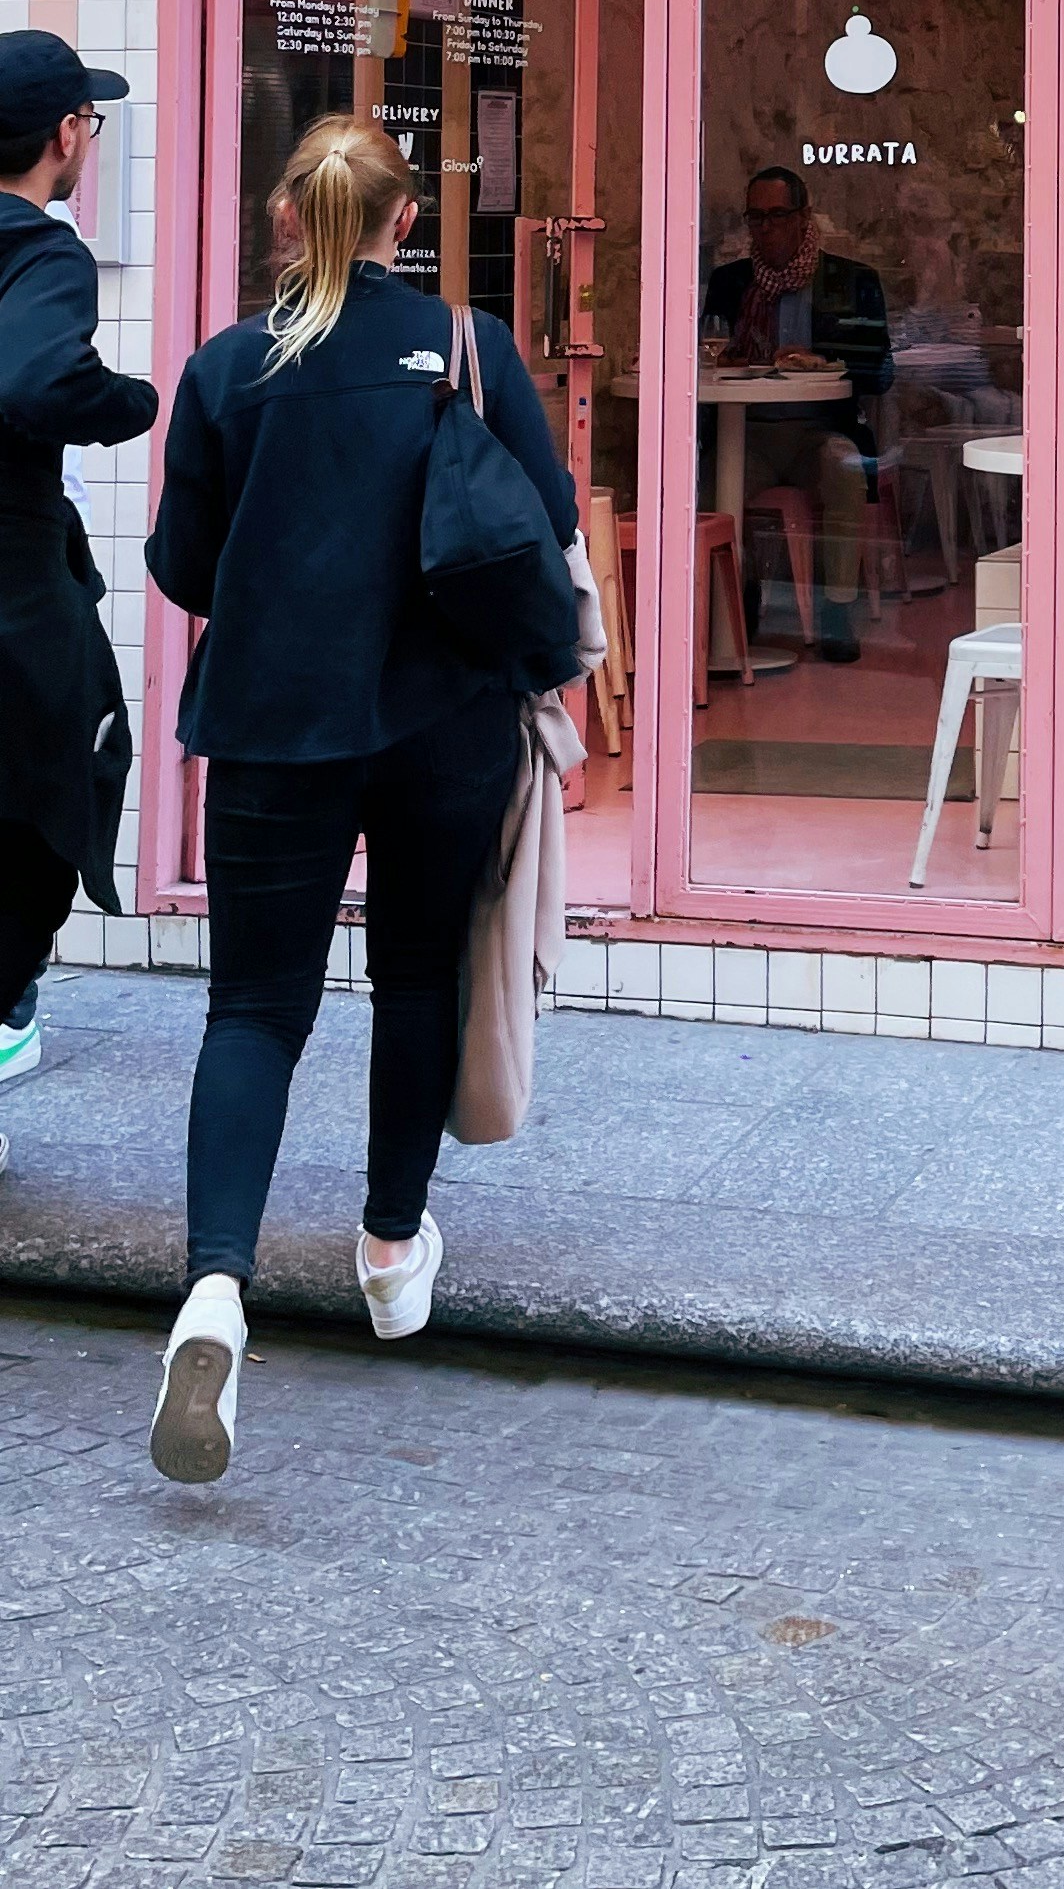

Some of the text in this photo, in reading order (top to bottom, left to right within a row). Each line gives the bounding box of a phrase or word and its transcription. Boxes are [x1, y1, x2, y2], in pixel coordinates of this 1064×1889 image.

[297, 0, 335, 14] Monday
[336, 2, 347, 13] to
[349, 3, 380, 17] Friday
[304, 15, 320, 25] am
[321, 15, 332, 26] to
[334, 16, 356, 27] 2:30
[357, 20, 372, 30] pm
[432, 10, 543, 33] From Sunday to Thursday
[276, 25, 372, 44] Saturday to Sunday
[445, 25, 531, 44] 7:00 pm to 10:30 pm
[276, 39, 372, 57] 12:30 pm to 3:00 pm
[446, 38, 529, 57] Friday to Saturday
[445, 51, 466, 63] 7:00
[467, 55, 481, 66] pm
[482, 55, 492, 65] to
[515, 59, 529, 69] pm
[802, 141, 917, 166] BURRATA
[441, 159, 478, 174] Glovo
